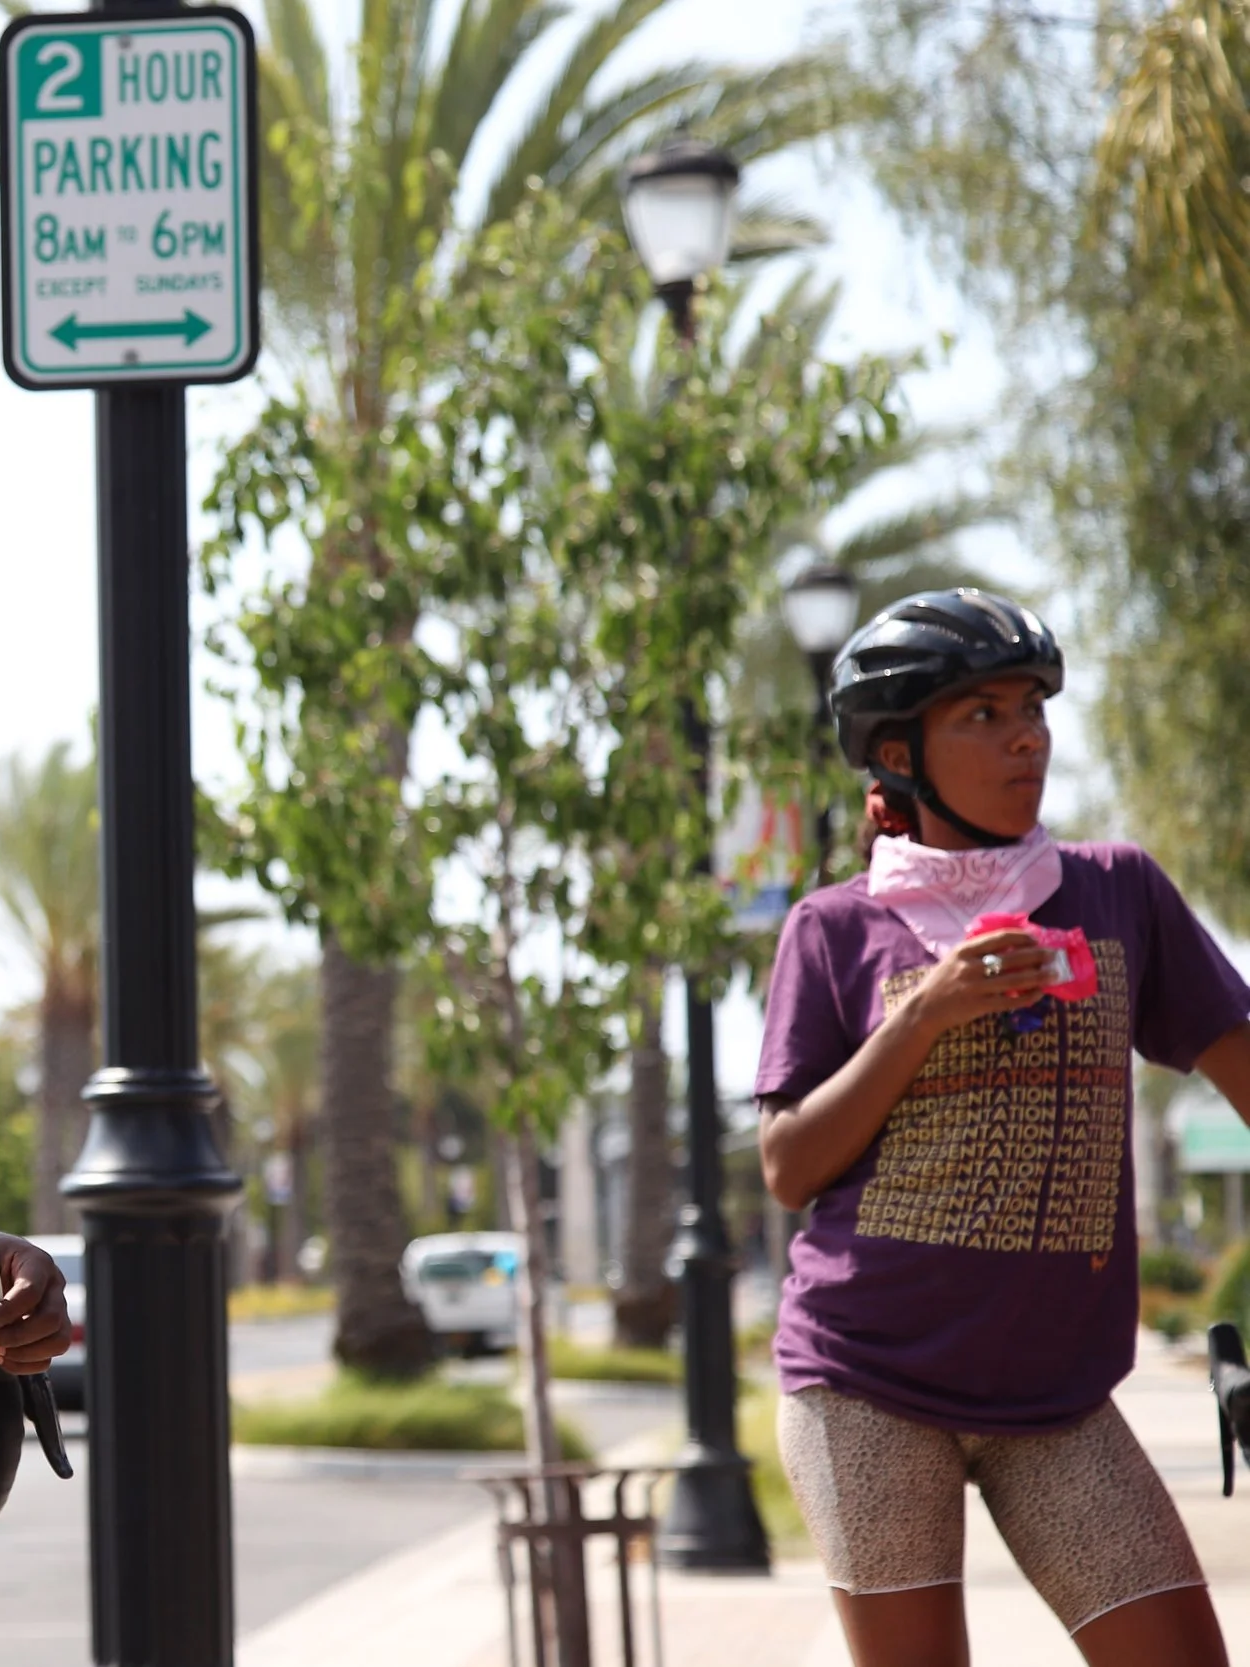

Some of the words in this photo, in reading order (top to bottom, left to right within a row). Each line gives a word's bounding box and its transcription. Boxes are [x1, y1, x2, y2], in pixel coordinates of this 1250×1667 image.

[35, 40, 84, 112] 2
[117, 50, 223, 105] HOUR
[32, 131, 223, 196] PARKING
[34, 213, 107, 264] 8AM
[152, 208, 226, 260] 6PM
[35, 275, 107, 298] EXCEPT
[135, 271, 223, 294] SUNDAYS
[1066, 1012, 1130, 1031] MATTERS
[1066, 1031, 1130, 1050] MATTERS
[1066, 1049, 1127, 1068] MATTERS
[1065, 1067, 1125, 1086] MATTERS
[1065, 1086, 1125, 1104] MATTERS
[1064, 1105, 1125, 1122] MATTERS
[1061, 1123, 1124, 1141] MATTERS
[1056, 1142, 1122, 1160] MATTERS
[1053, 1161, 1120, 1179] MATTERS
[1049, 1179, 1119, 1197] MATTERS
[862, 1186, 1039, 1215] REPRESENTATION
[1046, 1198, 1118, 1216] MATTERS
[857, 1203, 1036, 1233] REPRESENTATION
[1044, 1216, 1116, 1234] MATTERS
[854, 1220, 1032, 1252] REPRESENTATION
[1038, 1234, 1114, 1253] MATTERS
